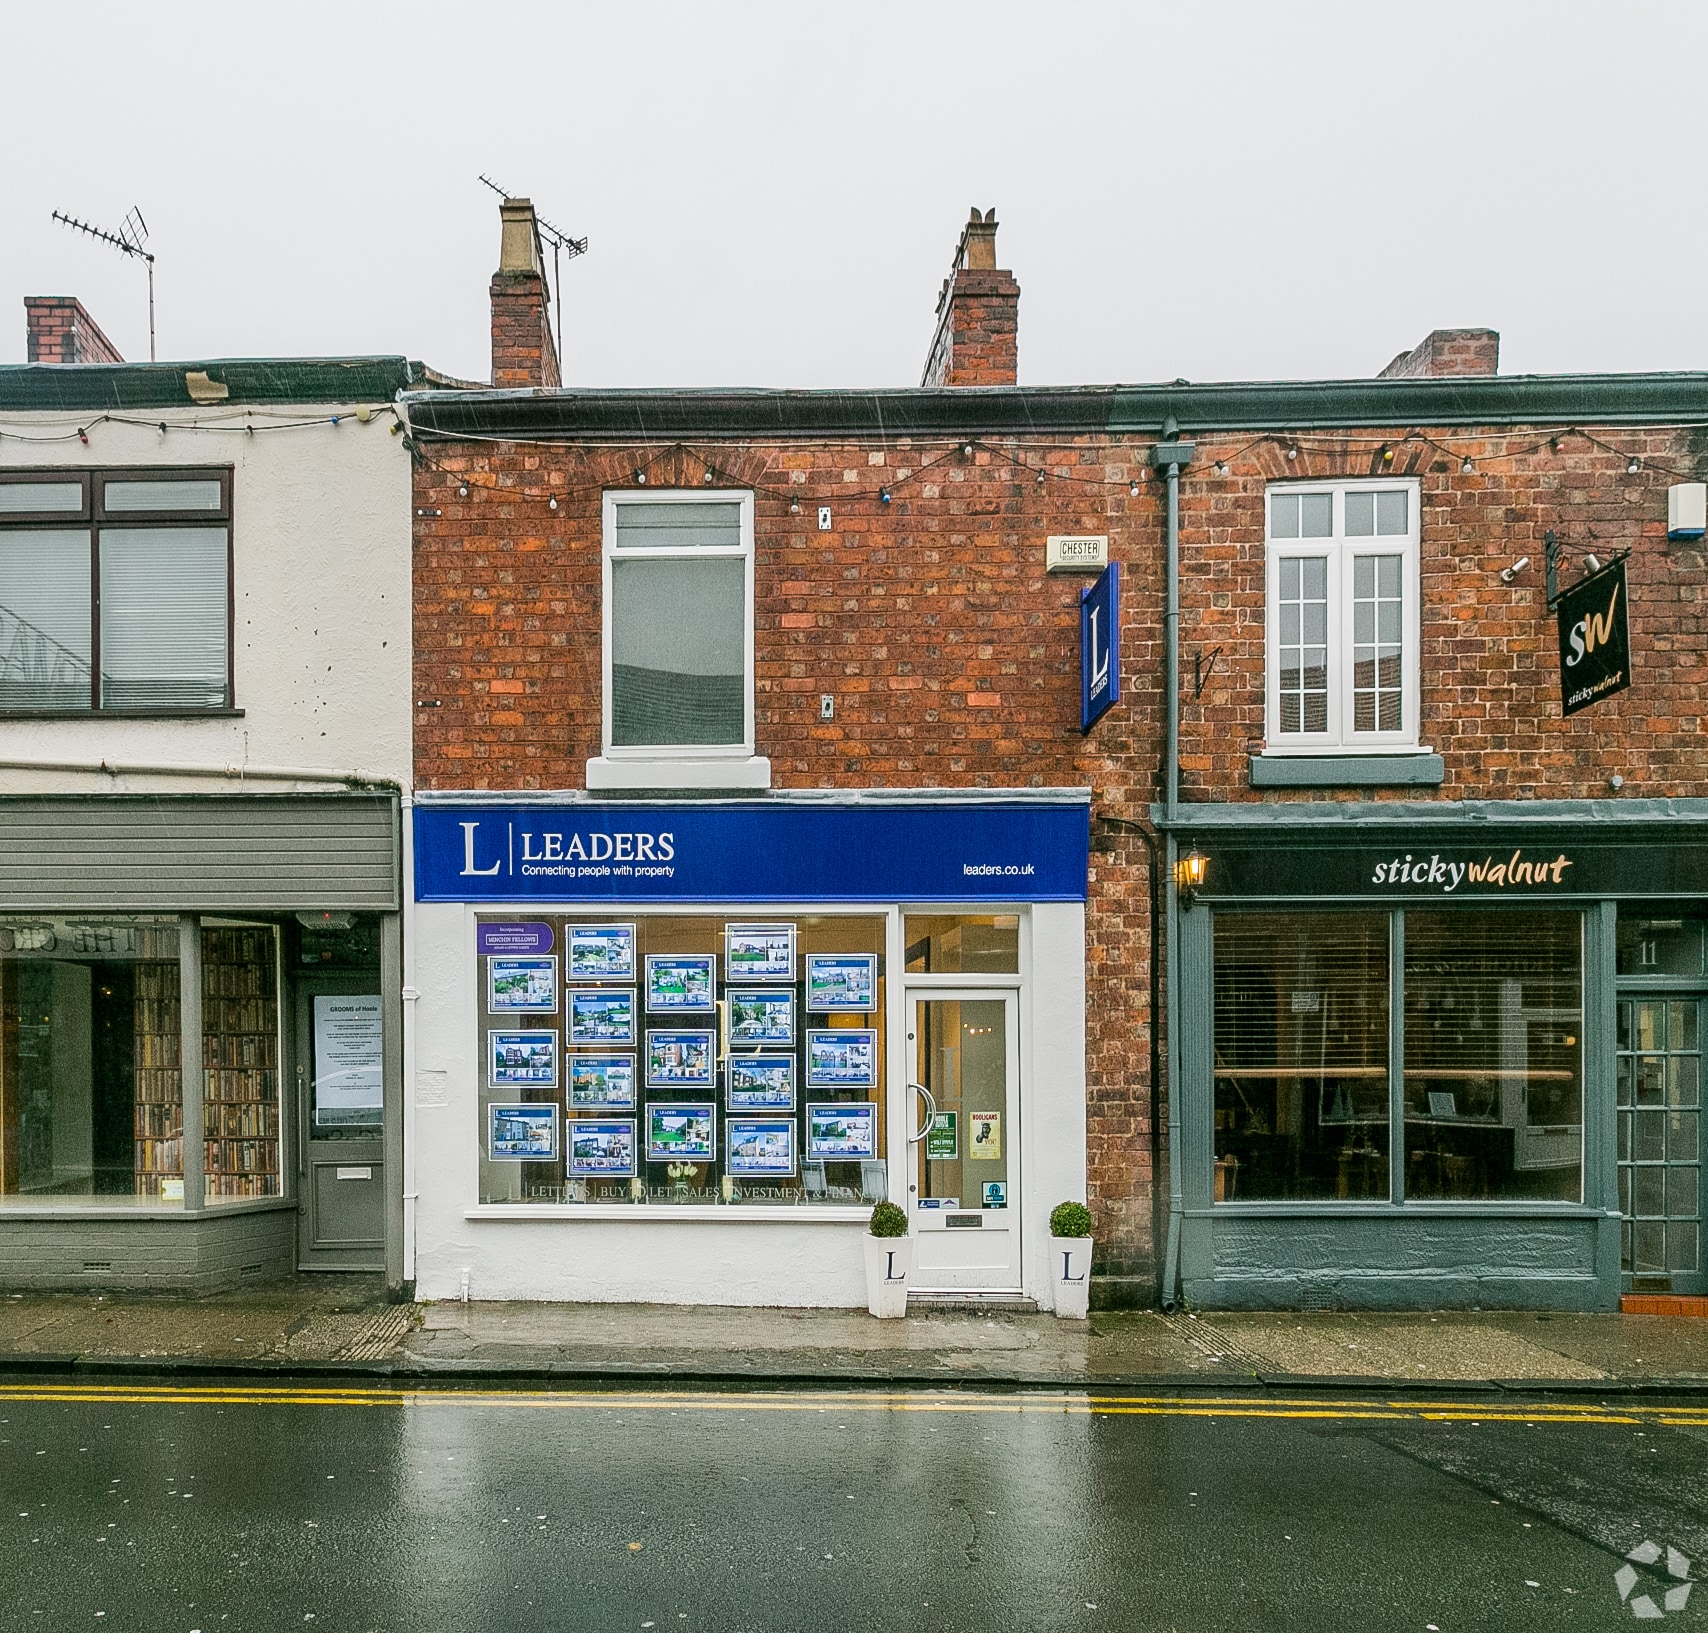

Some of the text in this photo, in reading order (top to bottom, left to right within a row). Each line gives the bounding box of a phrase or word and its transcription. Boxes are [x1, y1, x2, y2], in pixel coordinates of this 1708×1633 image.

[1062, 542, 1098, 555] CHESTER
[1090, 605, 1109, 688] L
[1090, 673, 1108, 701] LEADERS
[459, 822, 501, 876] L
[521, 832, 675, 862] LEADERS
[521, 864, 675, 878] Connecting people with property
[963, 863, 1035, 876] leaders.co.uk
[531, 1186, 591, 1197] LETTIS
[600, 1186, 627, 1197] BUY
[649, 1186, 673, 1197] LET
[682, 1186, 720, 1198] SALES
[727, 1186, 809, 1198] NVESTMENT
[884, 1251, 906, 1281] L
[1061, 1251, 1086, 1281] L
